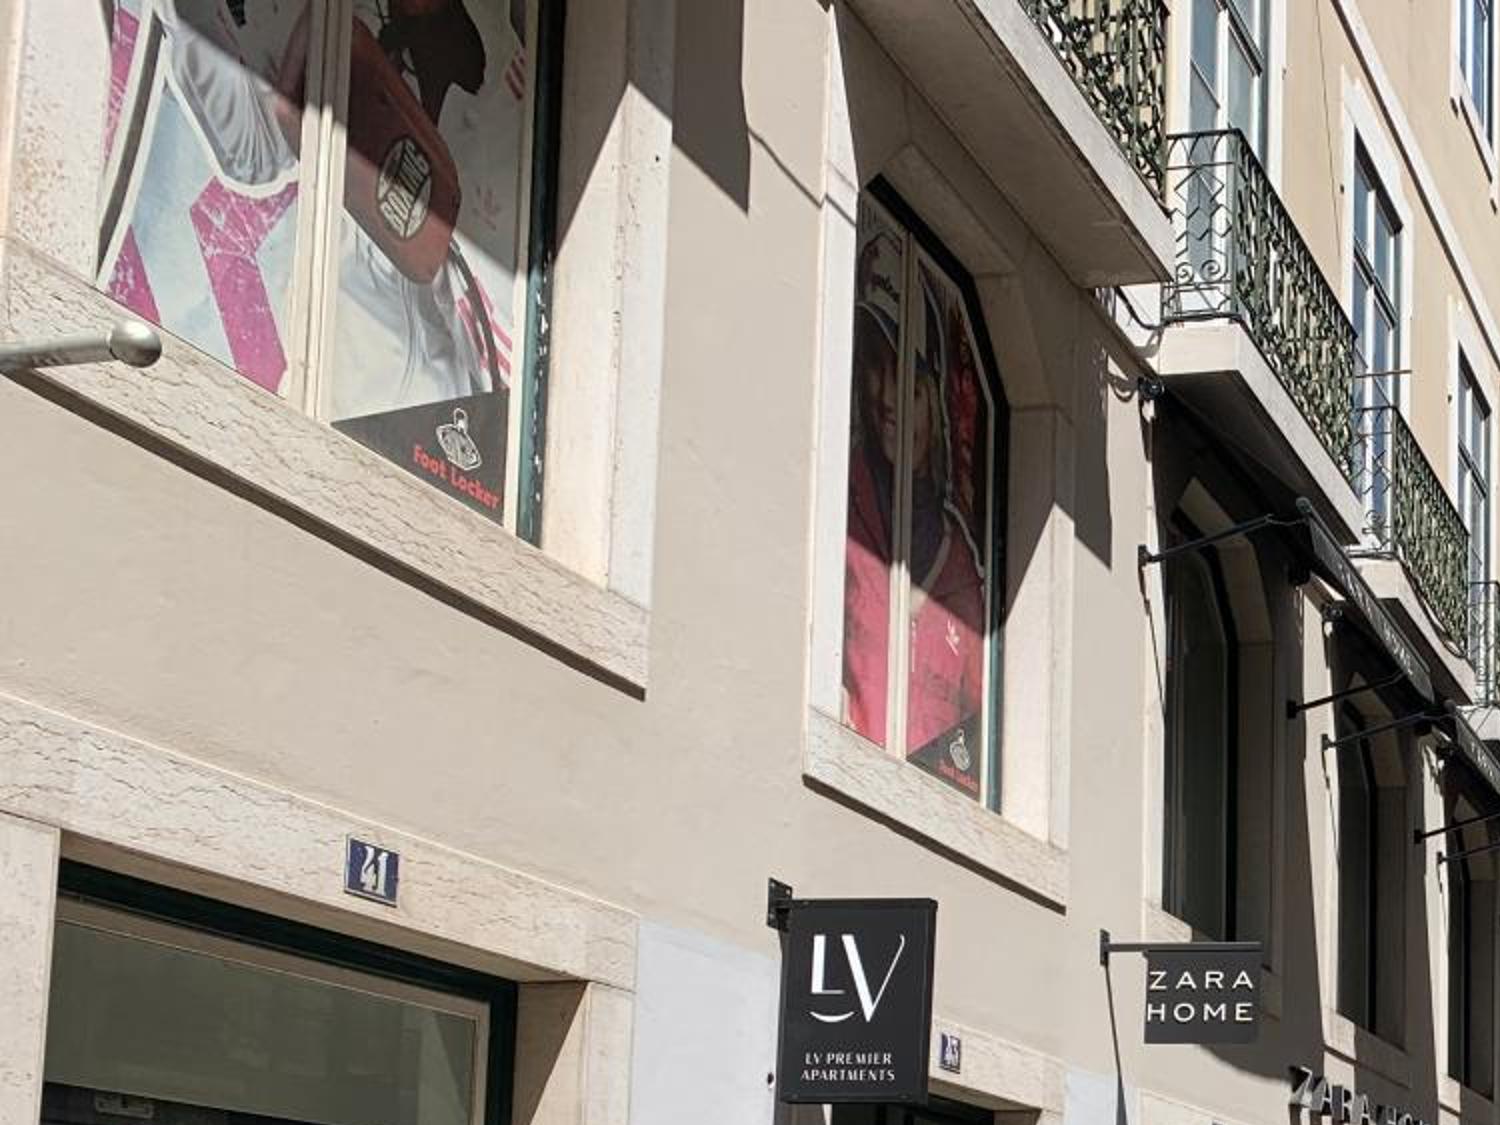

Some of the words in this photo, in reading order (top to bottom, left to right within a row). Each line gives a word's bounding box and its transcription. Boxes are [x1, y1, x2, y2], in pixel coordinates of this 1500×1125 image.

[414, 444, 449, 480] Foot
[450, 465, 501, 509] Locker
[360, 845, 389, 896] 41
[811, 934, 905, 1022] LV
[1149, 970, 1254, 990] ZARA
[1147, 1003, 1253, 1022] HOME
[805, 1052, 823, 1065] LV
[827, 1052, 893, 1065] PREMIER
[801, 1069, 896, 1081] APARTMENTS
